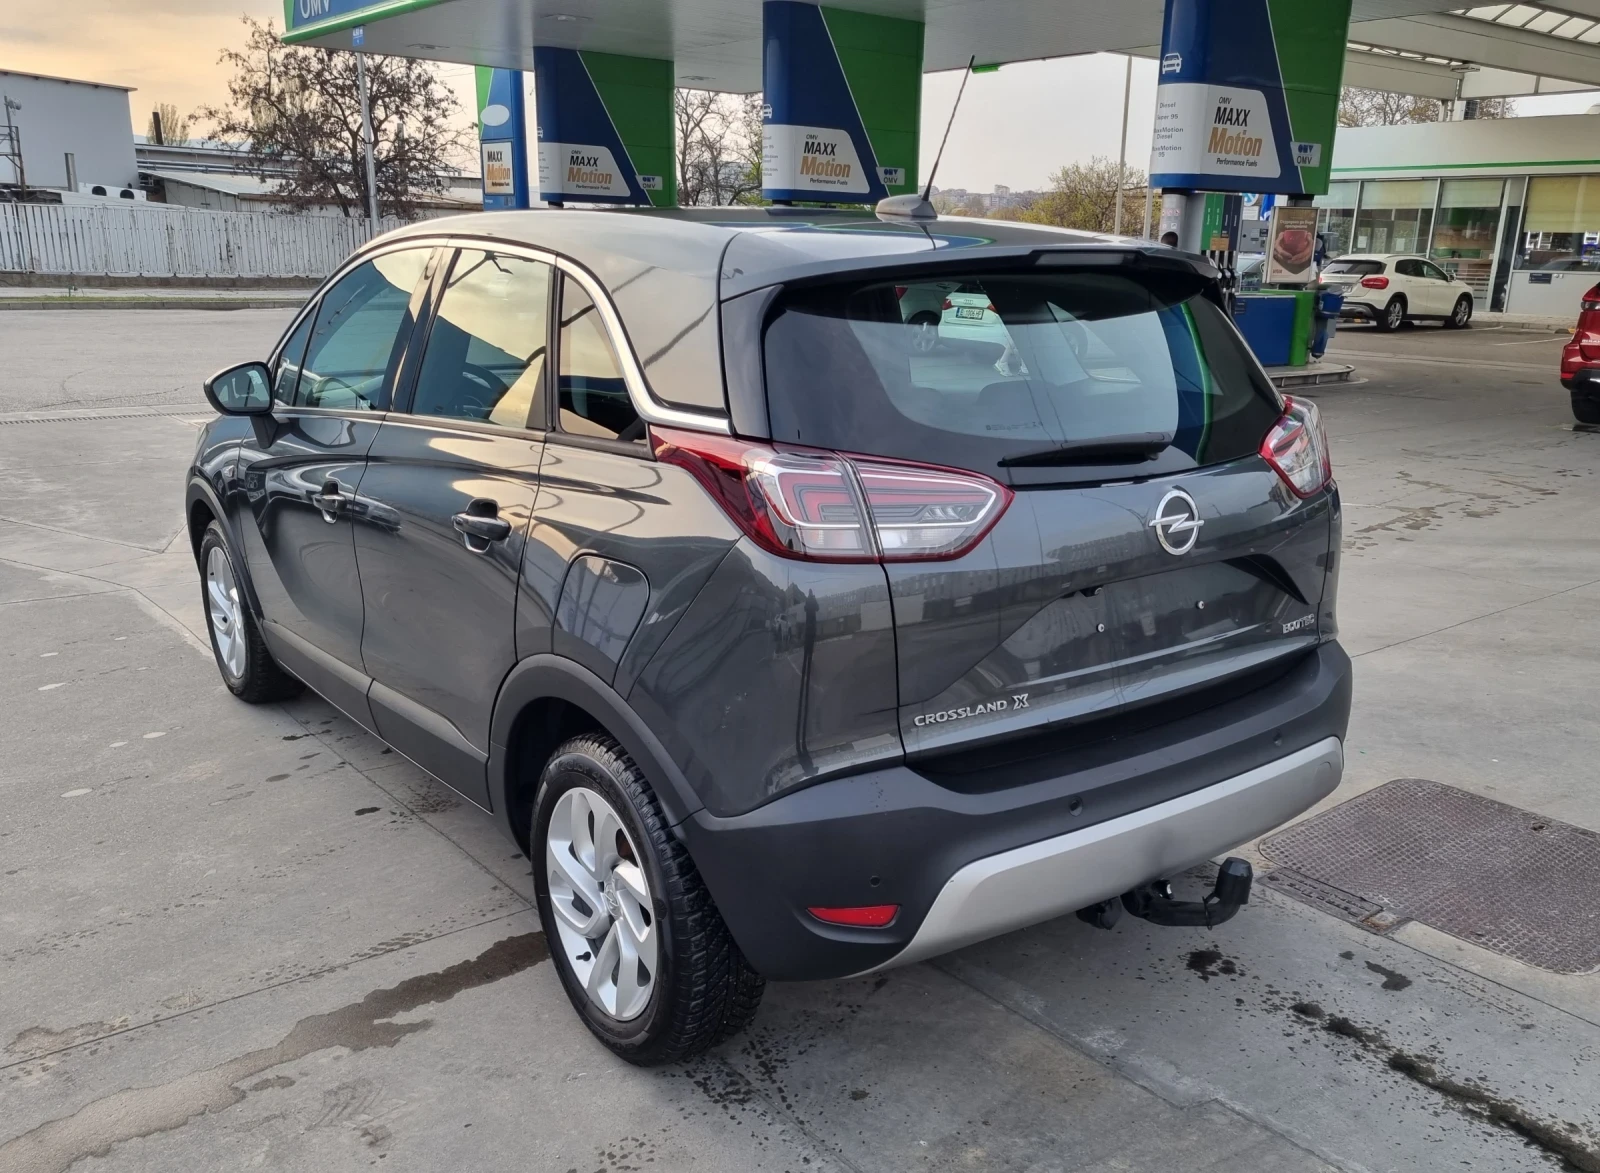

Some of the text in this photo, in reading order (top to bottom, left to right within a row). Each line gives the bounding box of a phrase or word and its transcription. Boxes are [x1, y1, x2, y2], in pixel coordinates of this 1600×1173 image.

[1218, 96, 1232, 105] OMV
[1214, 106, 1251, 127] MAXX
[803, 141, 837, 156] MAXX
[1208, 127, 1263, 157] Motion
[487, 150, 503, 162] MAXX
[569, 155, 599, 167] MAXX
[1216, 157, 1258, 167] Performance Fuels
[1296, 155, 1313, 165] OMV
[486, 163, 511, 181] Motion
[800, 156, 851, 178] Motion
[567, 166, 612, 185] Motion
[914, 693, 1030, 726] CROSSLAND X
